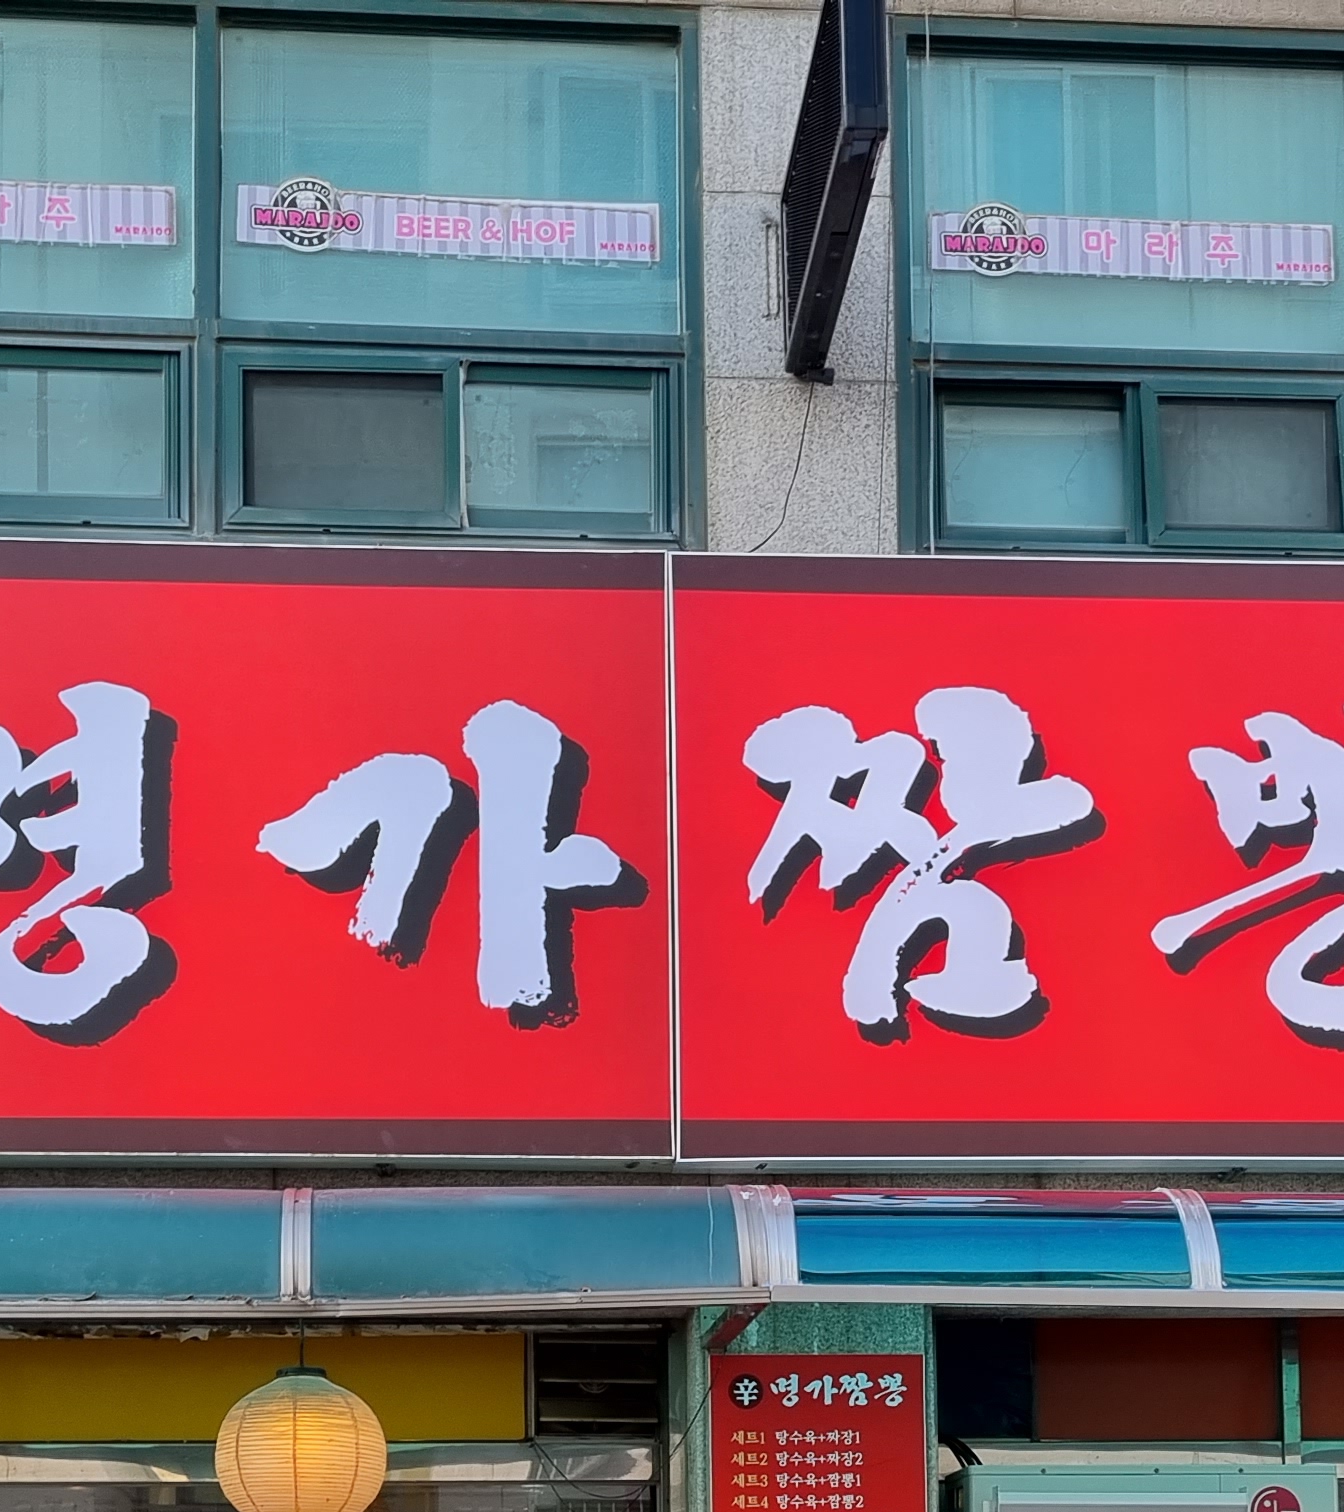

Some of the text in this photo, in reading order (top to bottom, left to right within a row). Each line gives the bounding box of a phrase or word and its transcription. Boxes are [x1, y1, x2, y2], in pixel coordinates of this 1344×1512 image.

[254, 208, 361, 231] MARAJOO
[396, 214, 576, 243] BEER & HOF
[944, 233, 1047, 256] MARAJOO
[732, 1430, 859, 1445] 세트1 탕수육+짜장1
[732, 1451, 863, 1466] 세트2 탕수육+짜장2
[732, 1473, 860, 1488] 세트3 탕수육+짬뽕1
[732, 1494, 863, 1509] 세트4 탕수육+짬뽕2
